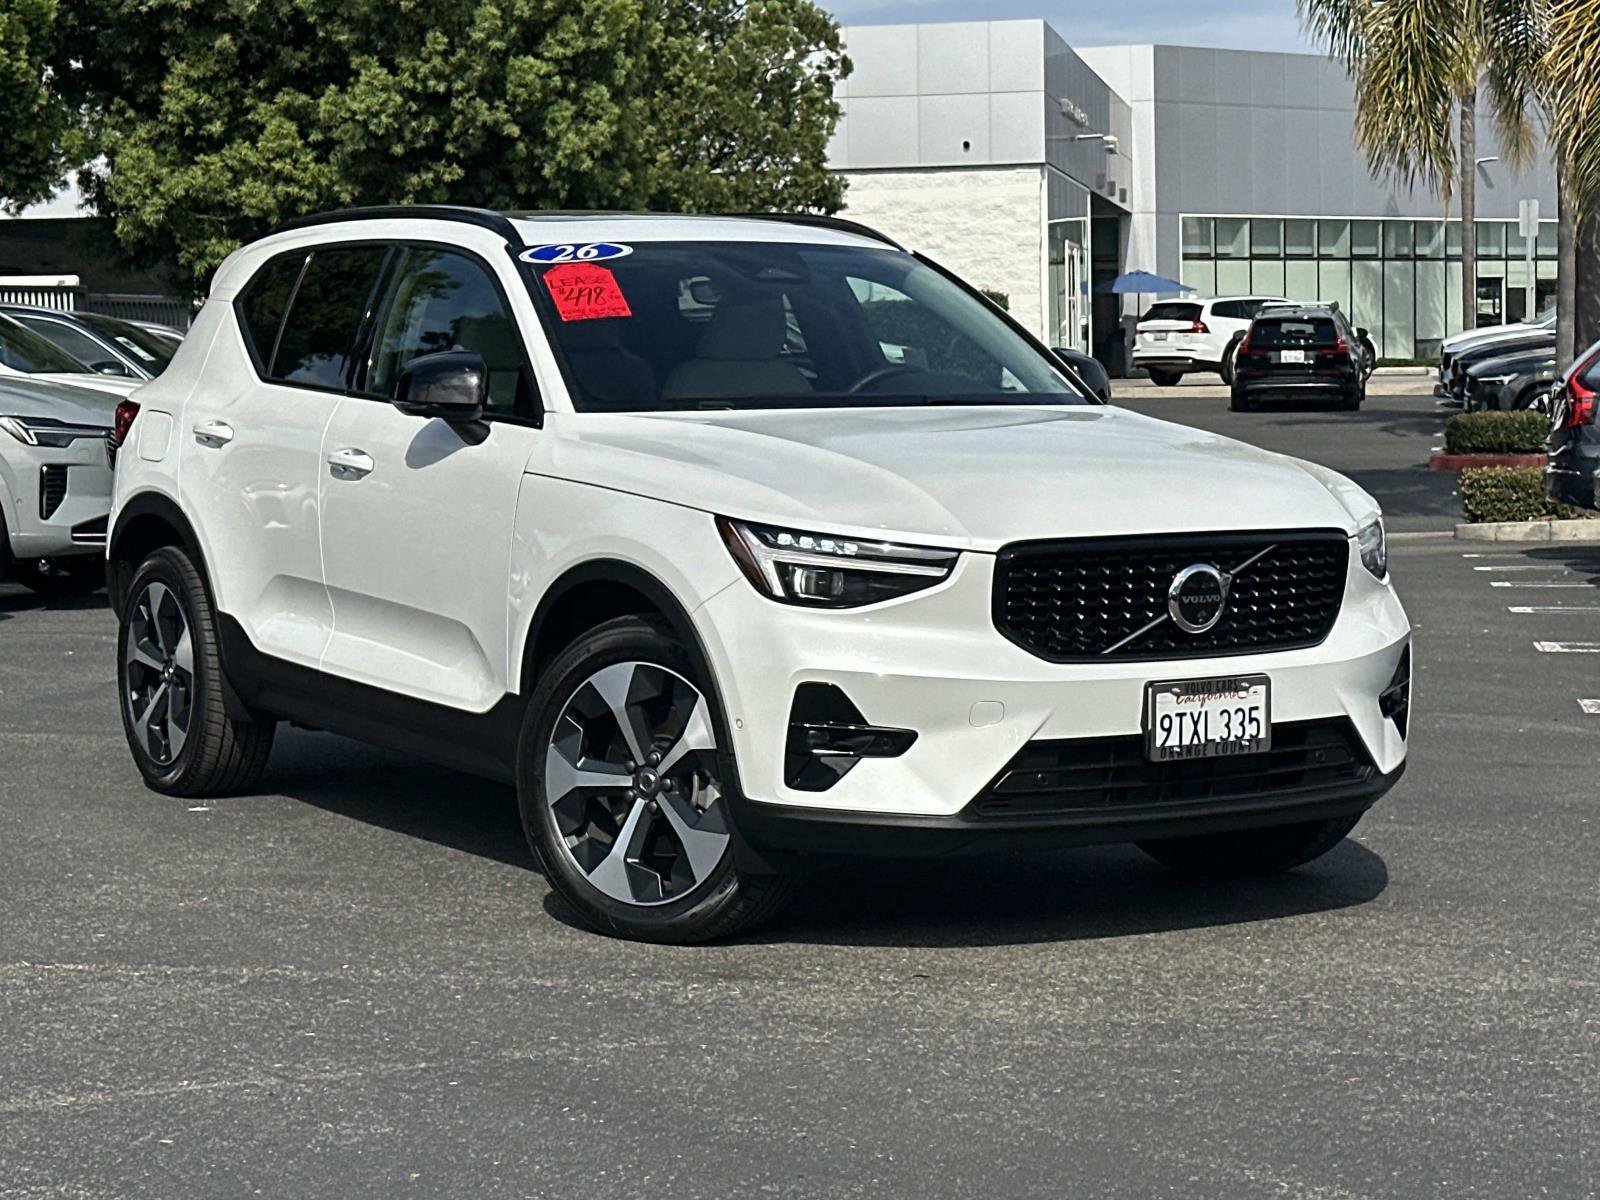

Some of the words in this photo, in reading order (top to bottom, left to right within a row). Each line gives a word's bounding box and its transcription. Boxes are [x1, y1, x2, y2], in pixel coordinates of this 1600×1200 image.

[552, 245, 598, 261] 26
[1182, 594, 1220, 604] VOLVO
[1184, 680, 1212, 694] VOLVO
[1216, 678, 1238, 692] CARS
[1160, 706, 1261, 747] 9TXL335
